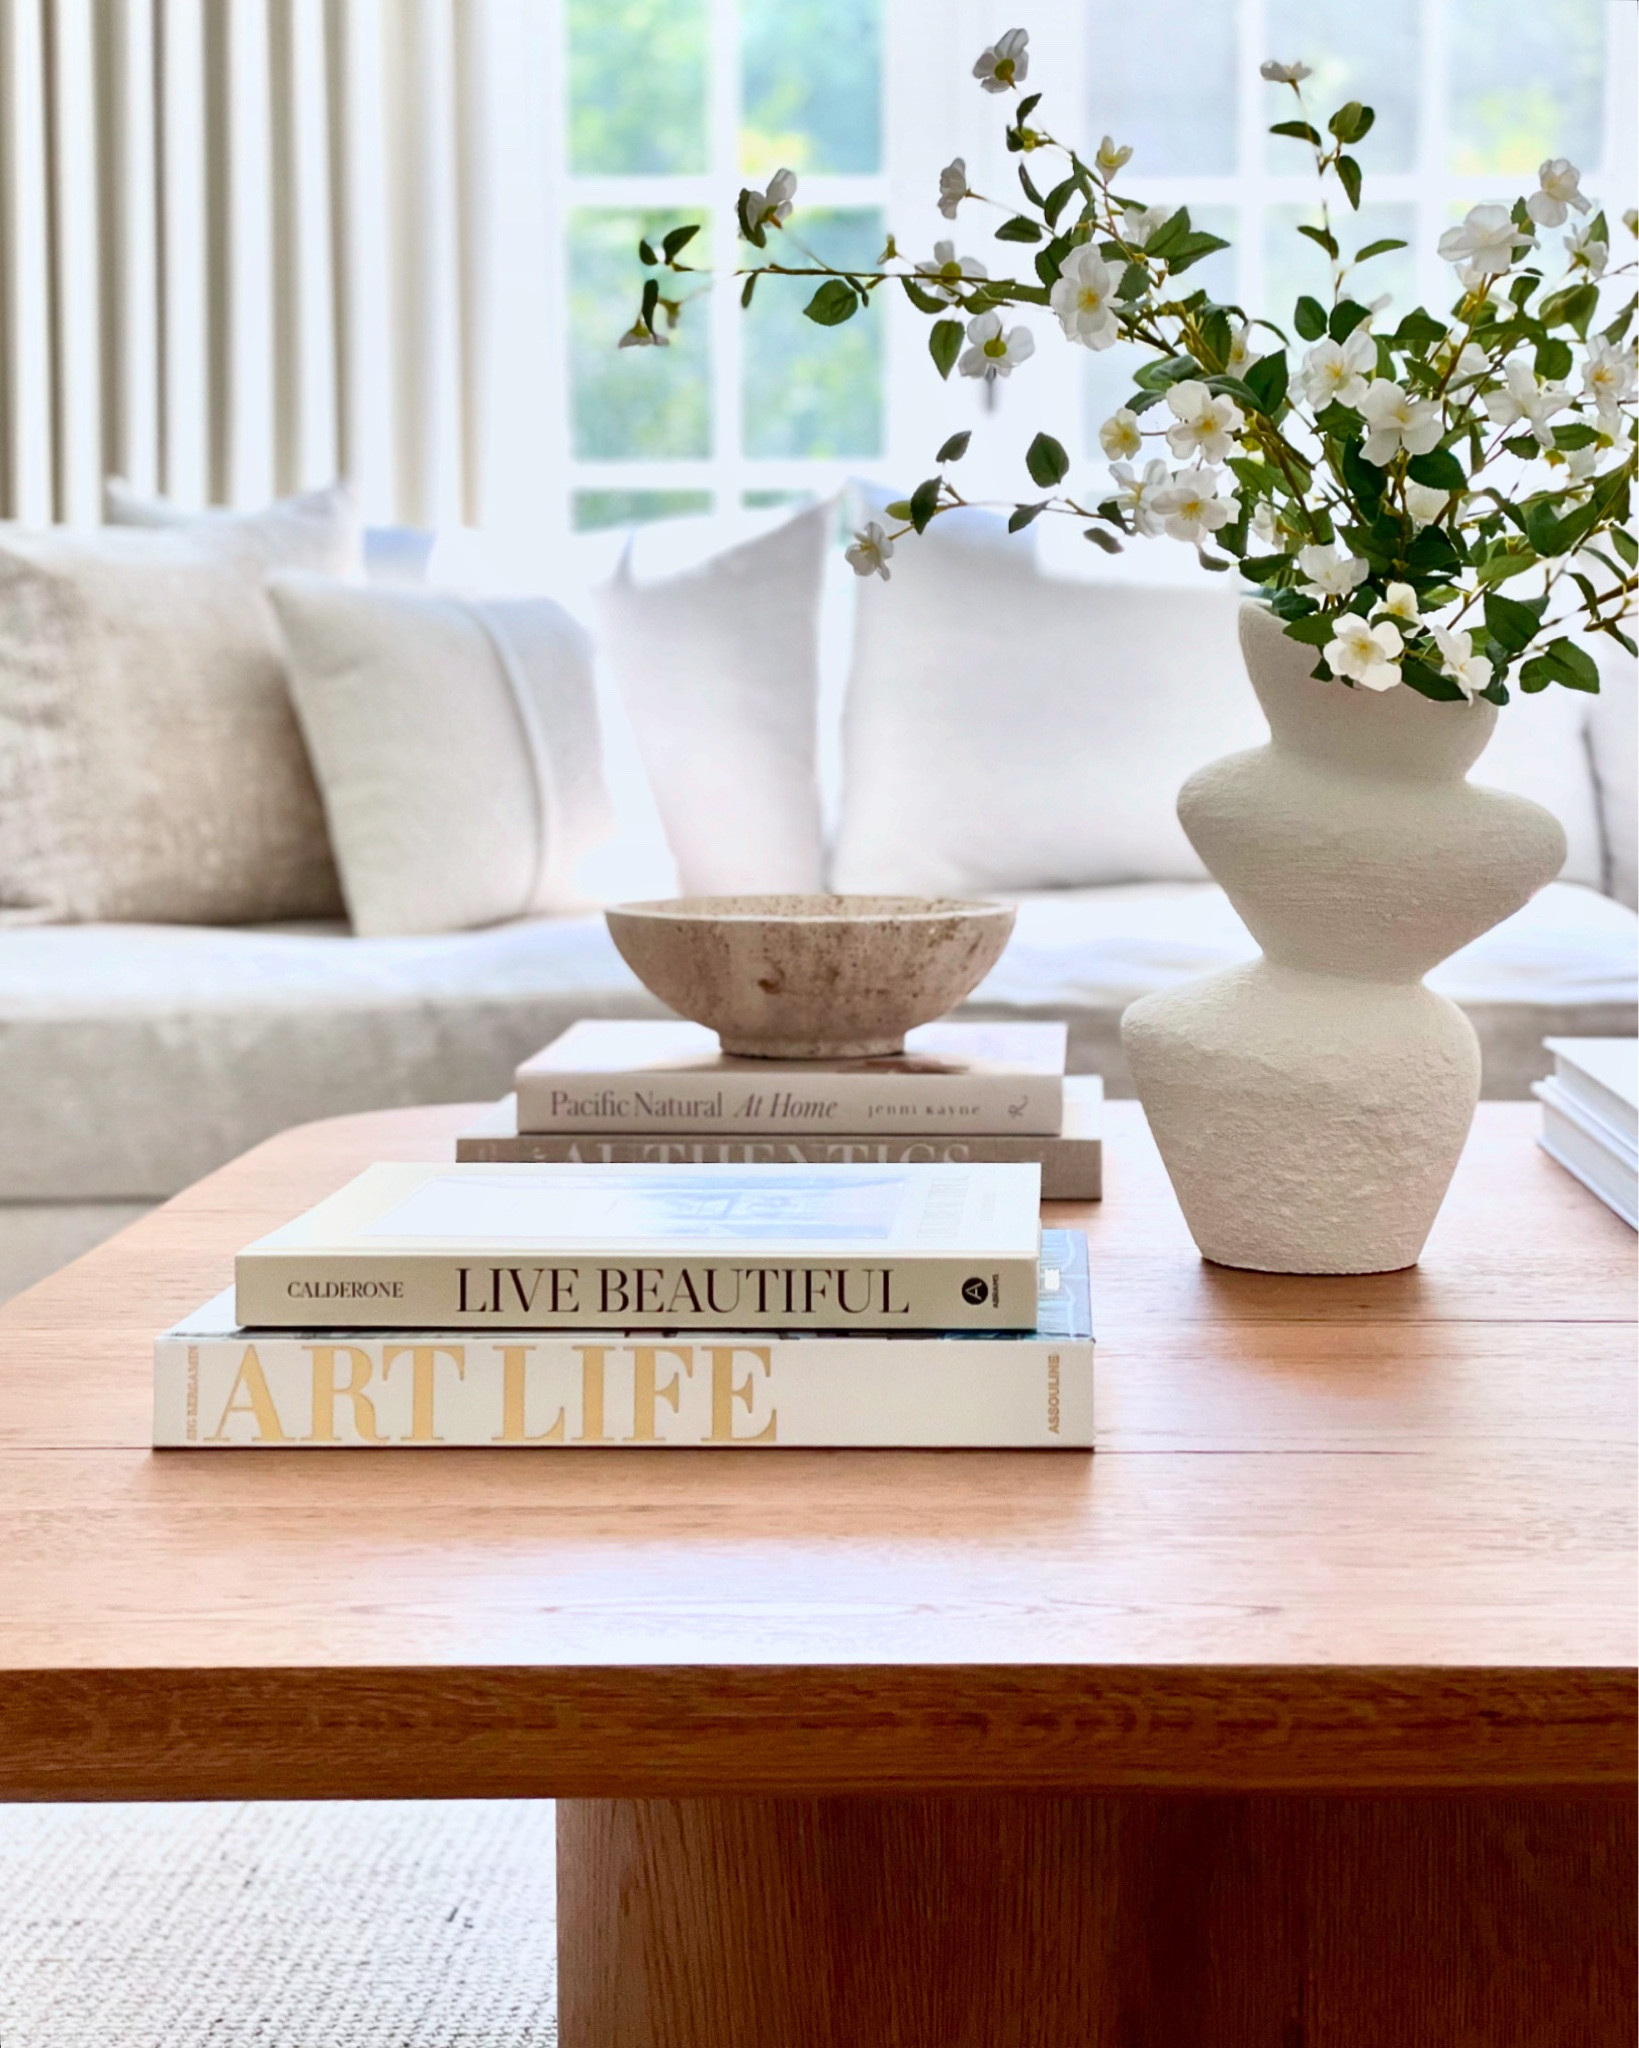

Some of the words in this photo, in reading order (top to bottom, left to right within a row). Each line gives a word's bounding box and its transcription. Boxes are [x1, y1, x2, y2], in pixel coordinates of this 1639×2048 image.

[551, 1090, 630, 1118] Pacific
[634, 1091, 723, 1118] Natural
[733, 1093, 763, 1118] At
[769, 1092, 839, 1119] Home
[286, 1280, 405, 1299] CALDERONE
[455, 1267, 581, 1313] LIVE
[597, 1268, 909, 1314] BEAUTIFUL
[202, 1344, 466, 1442] ART
[491, 1345, 778, 1443] LIFE
[1047, 1354, 1061, 1435] ASSOULINE
